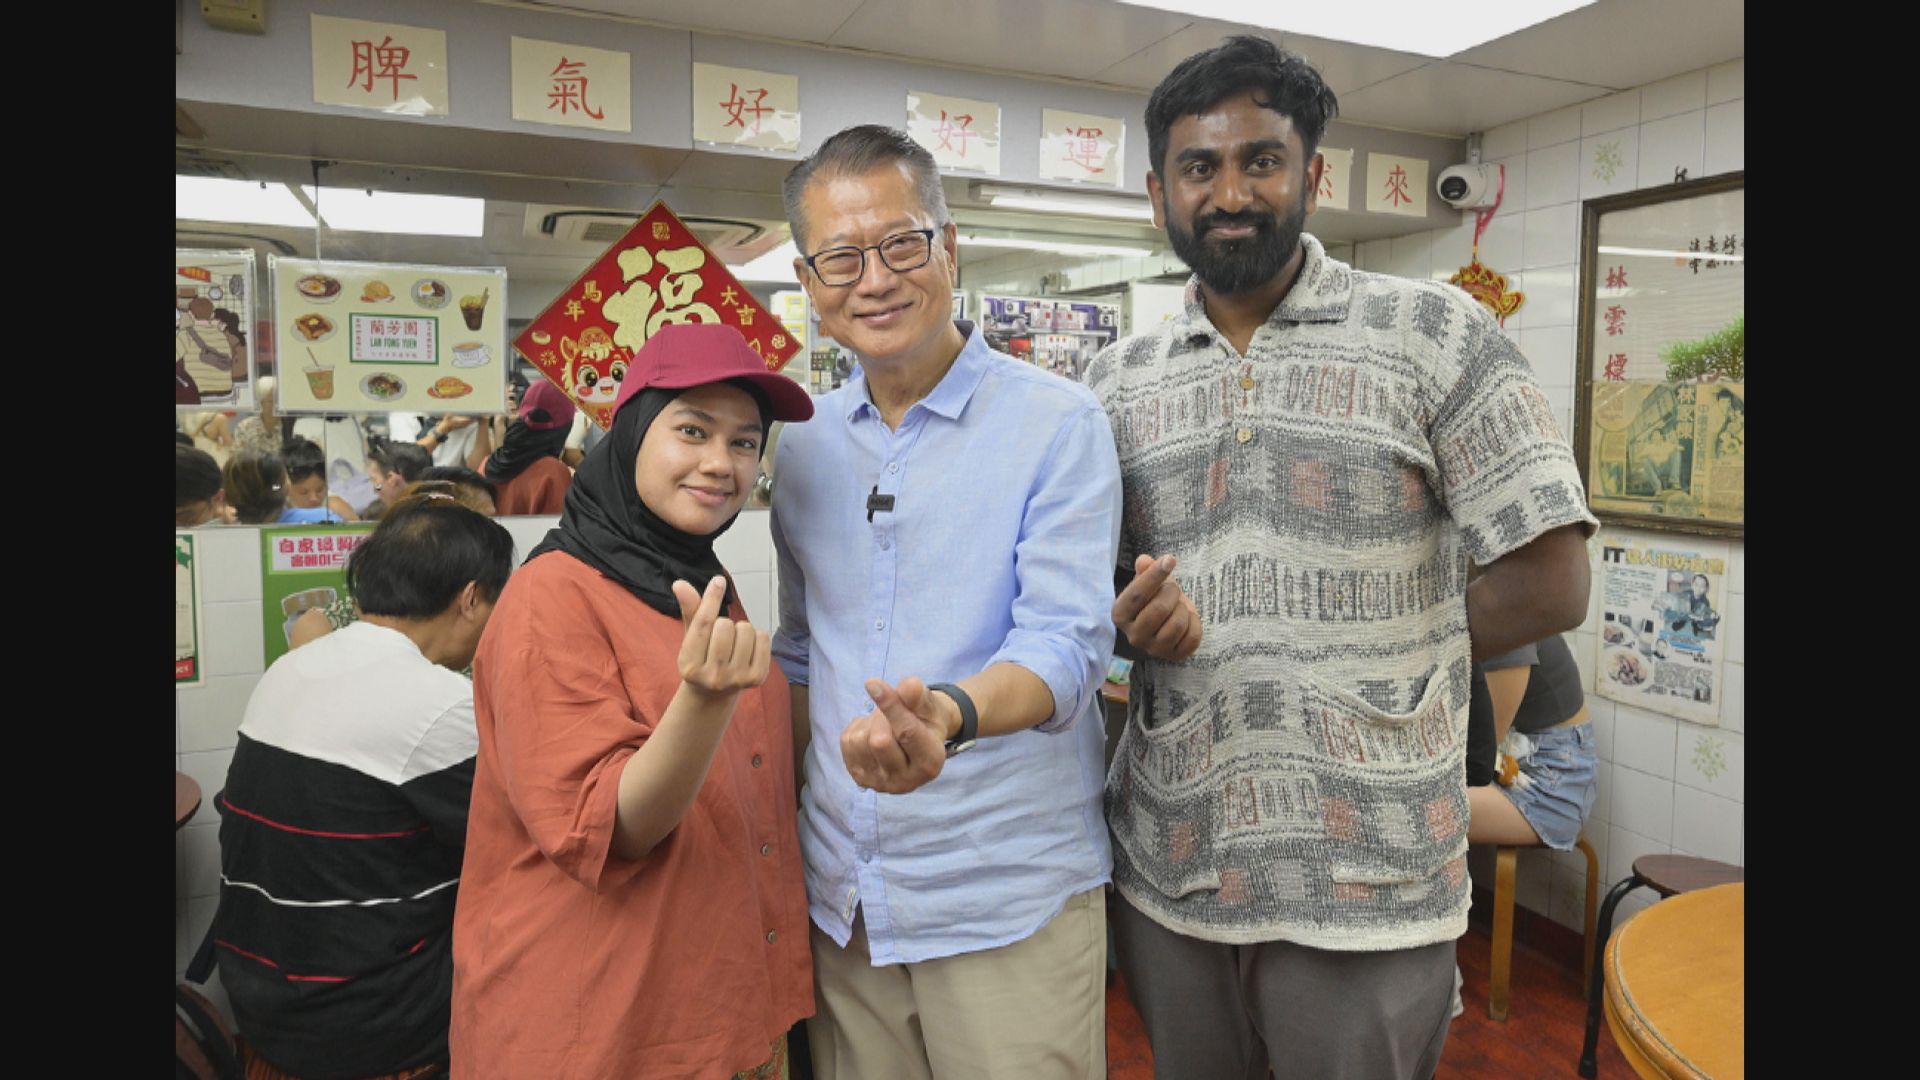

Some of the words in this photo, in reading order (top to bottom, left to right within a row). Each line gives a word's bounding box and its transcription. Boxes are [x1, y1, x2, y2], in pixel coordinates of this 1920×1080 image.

[347, 36, 418, 99] 脾
[547, 56, 604, 120] 氣
[719, 82, 775, 134] 好
[931, 110, 978, 159] 好
[1062, 126, 1105, 173] 運
[1383, 164, 1413, 207] 來
